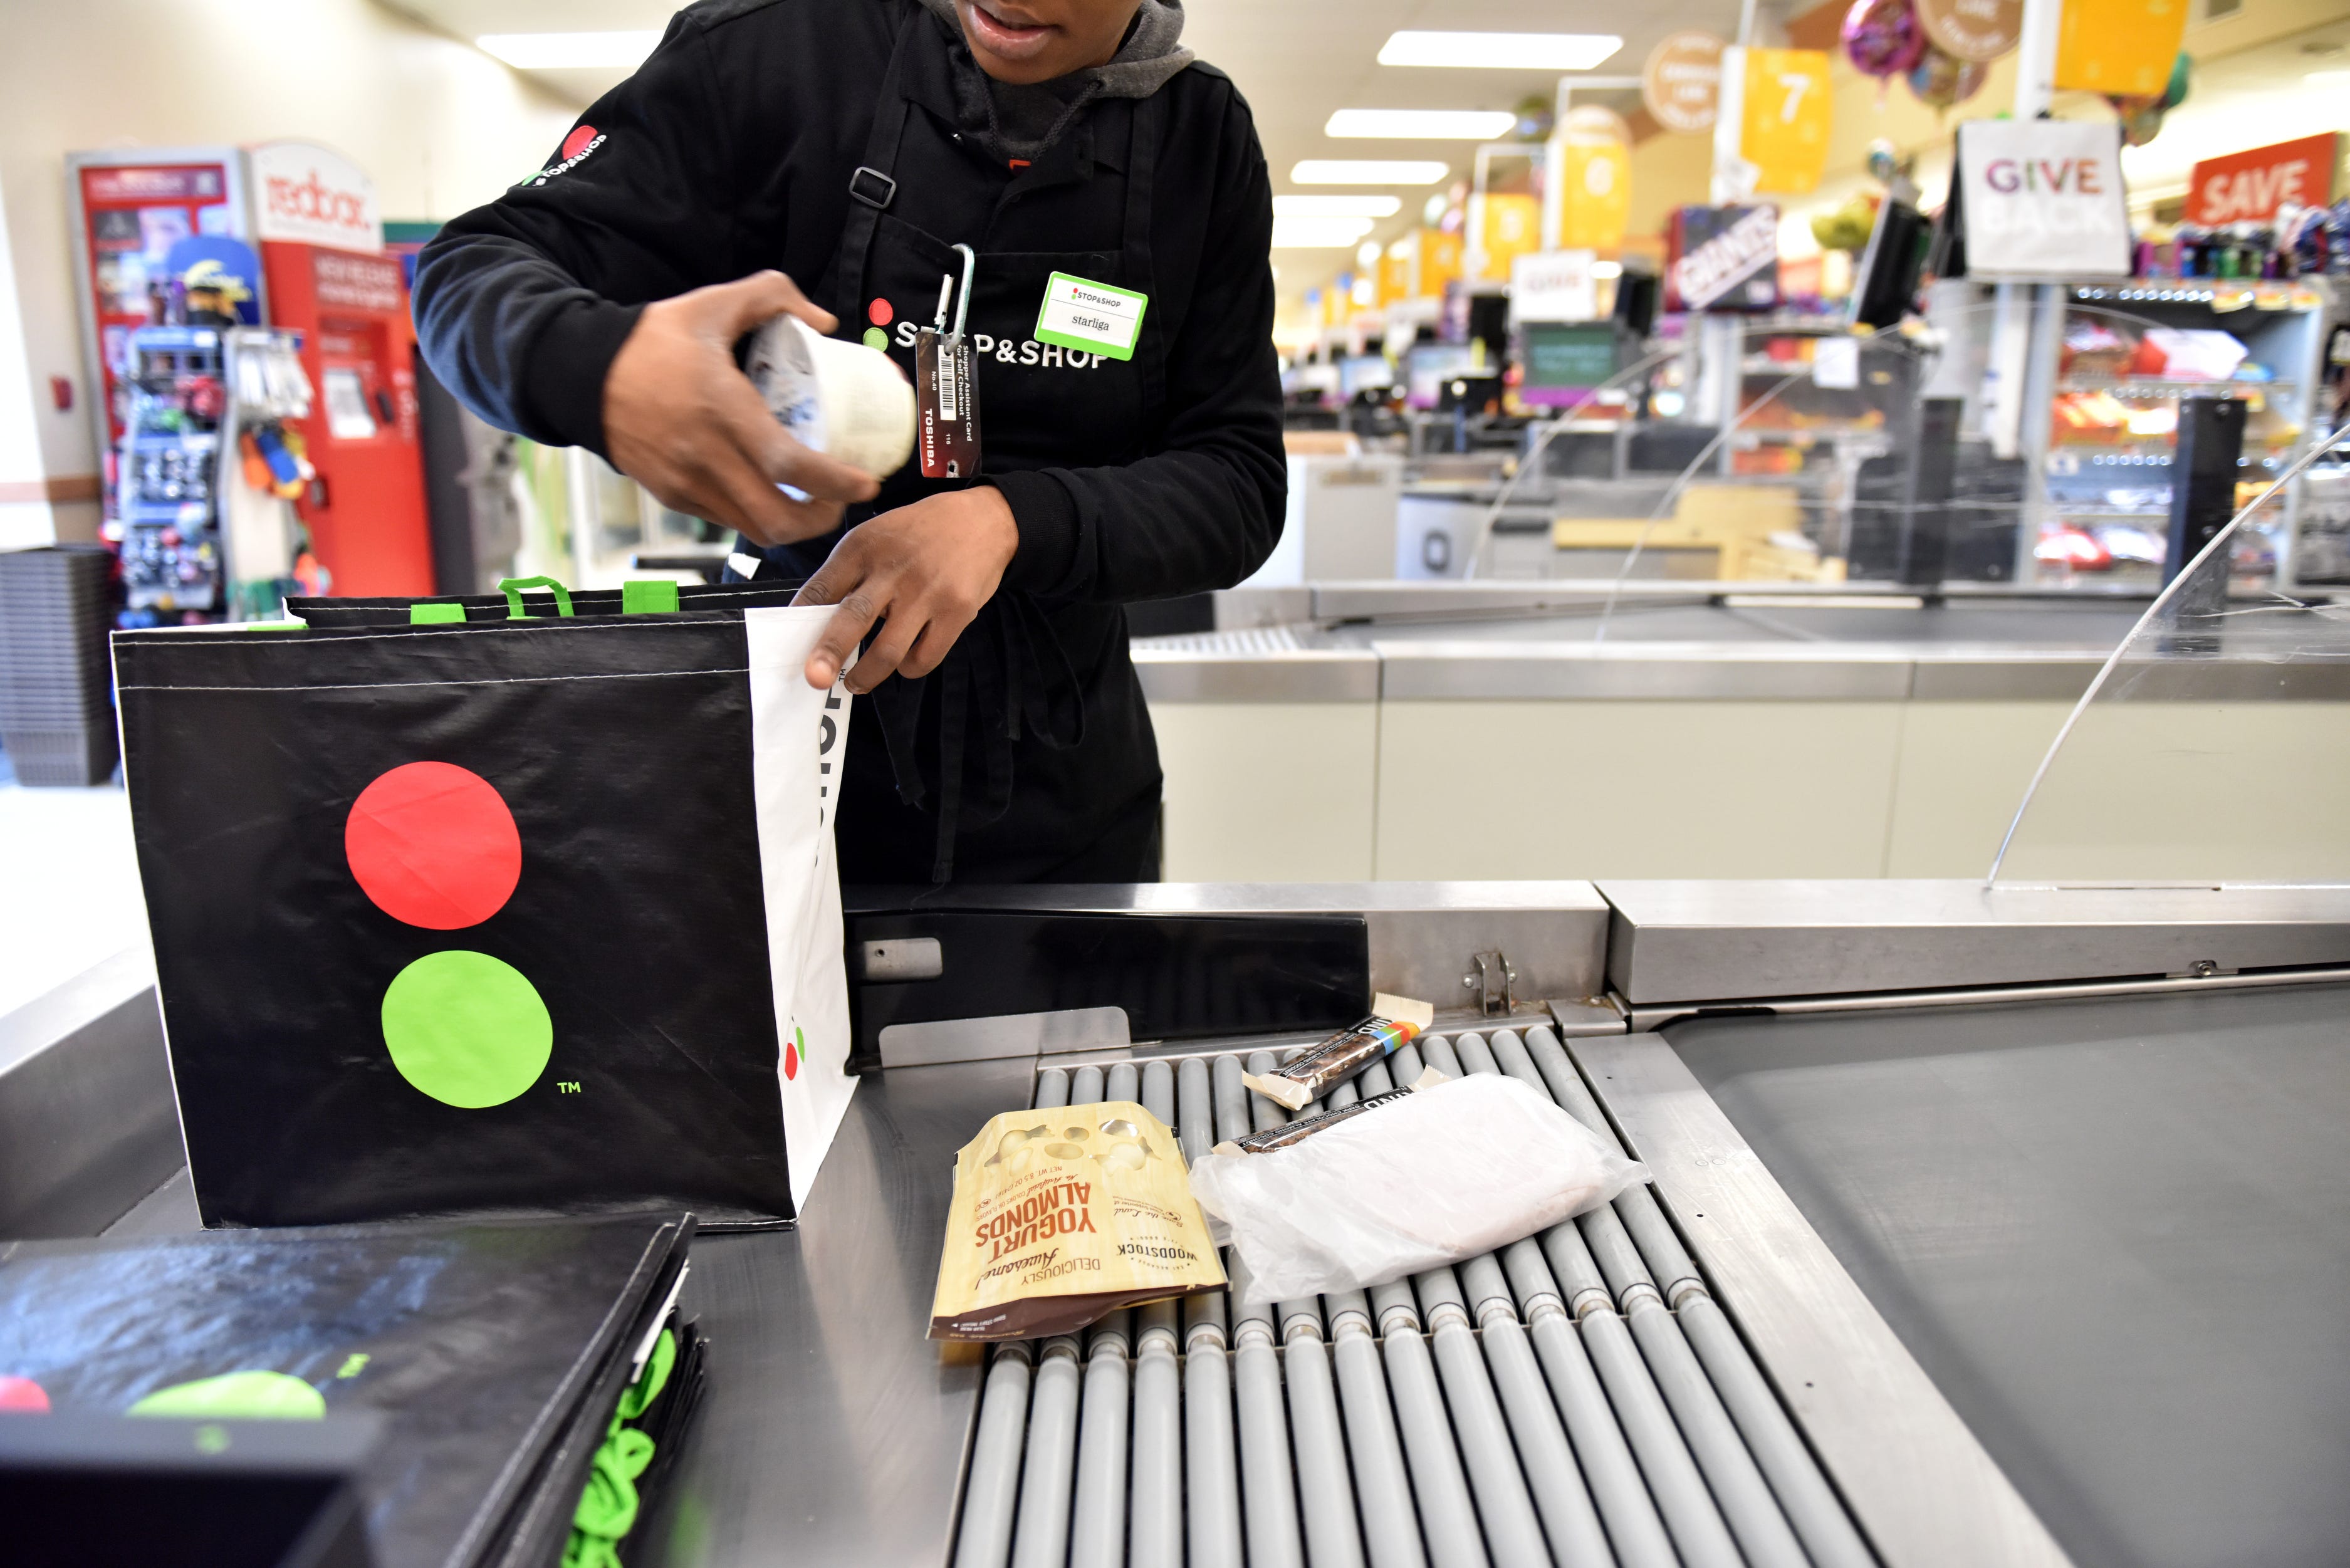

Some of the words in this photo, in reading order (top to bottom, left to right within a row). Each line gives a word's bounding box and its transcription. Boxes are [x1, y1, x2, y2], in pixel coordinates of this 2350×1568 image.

[1778, 73, 1810, 123] 7
[1985, 159, 2103, 194] GIVE
[2201, 159, 2309, 221] SAVE
[1077, 292, 1121, 308] STOP&SHOP
[1072, 316, 1109, 332] starliga
[925, 408, 935, 468] TOSHIBA
[557, 1082, 581, 1094] TM
[1303, 1111, 1341, 1126] CHOCOLATE
[1275, 1122, 1302, 1134] ALMOND
[1242, 1131, 1274, 1146] COCONUT
[1024, 1173, 1034, 1181] 8.5
[1006, 1191, 1026, 1205] COLORS
[975, 1182, 1091, 1247] ALMONDS
[976, 1206, 997, 1221] FLAVORS
[1114, 1208, 1141, 1218] Land
[988, 1208, 1097, 1265] YOGURT
[1117, 1244, 1198, 1261] WOODSTOCK
[1021, 1258, 1100, 1285] DELICIOUSLY
